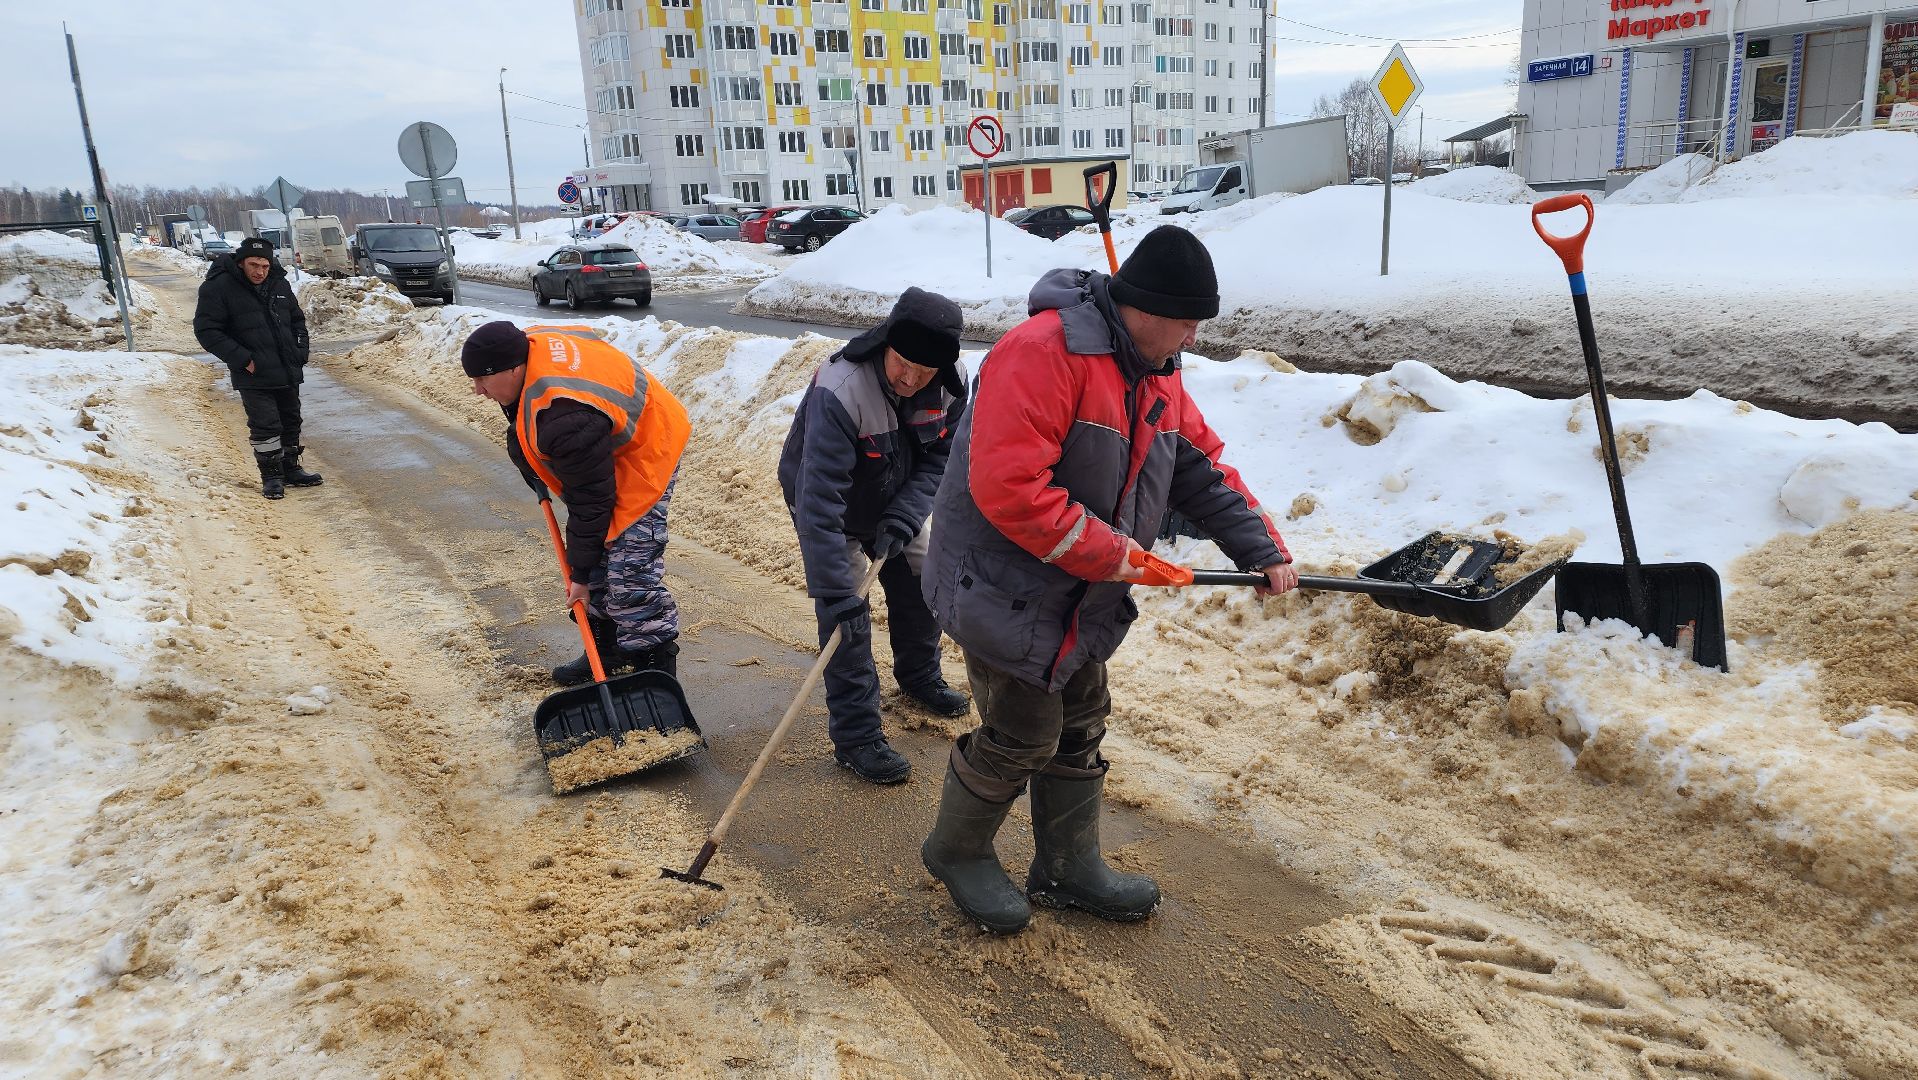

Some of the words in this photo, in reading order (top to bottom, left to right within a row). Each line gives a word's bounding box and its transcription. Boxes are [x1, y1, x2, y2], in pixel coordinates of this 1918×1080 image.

[1608, 9, 1711, 40] Маркет
[1534, 61, 1567, 73] ЗАРЕЧНАЯ
[1575, 59, 1588, 73] 14
[547, 336, 568, 363] МБУ
